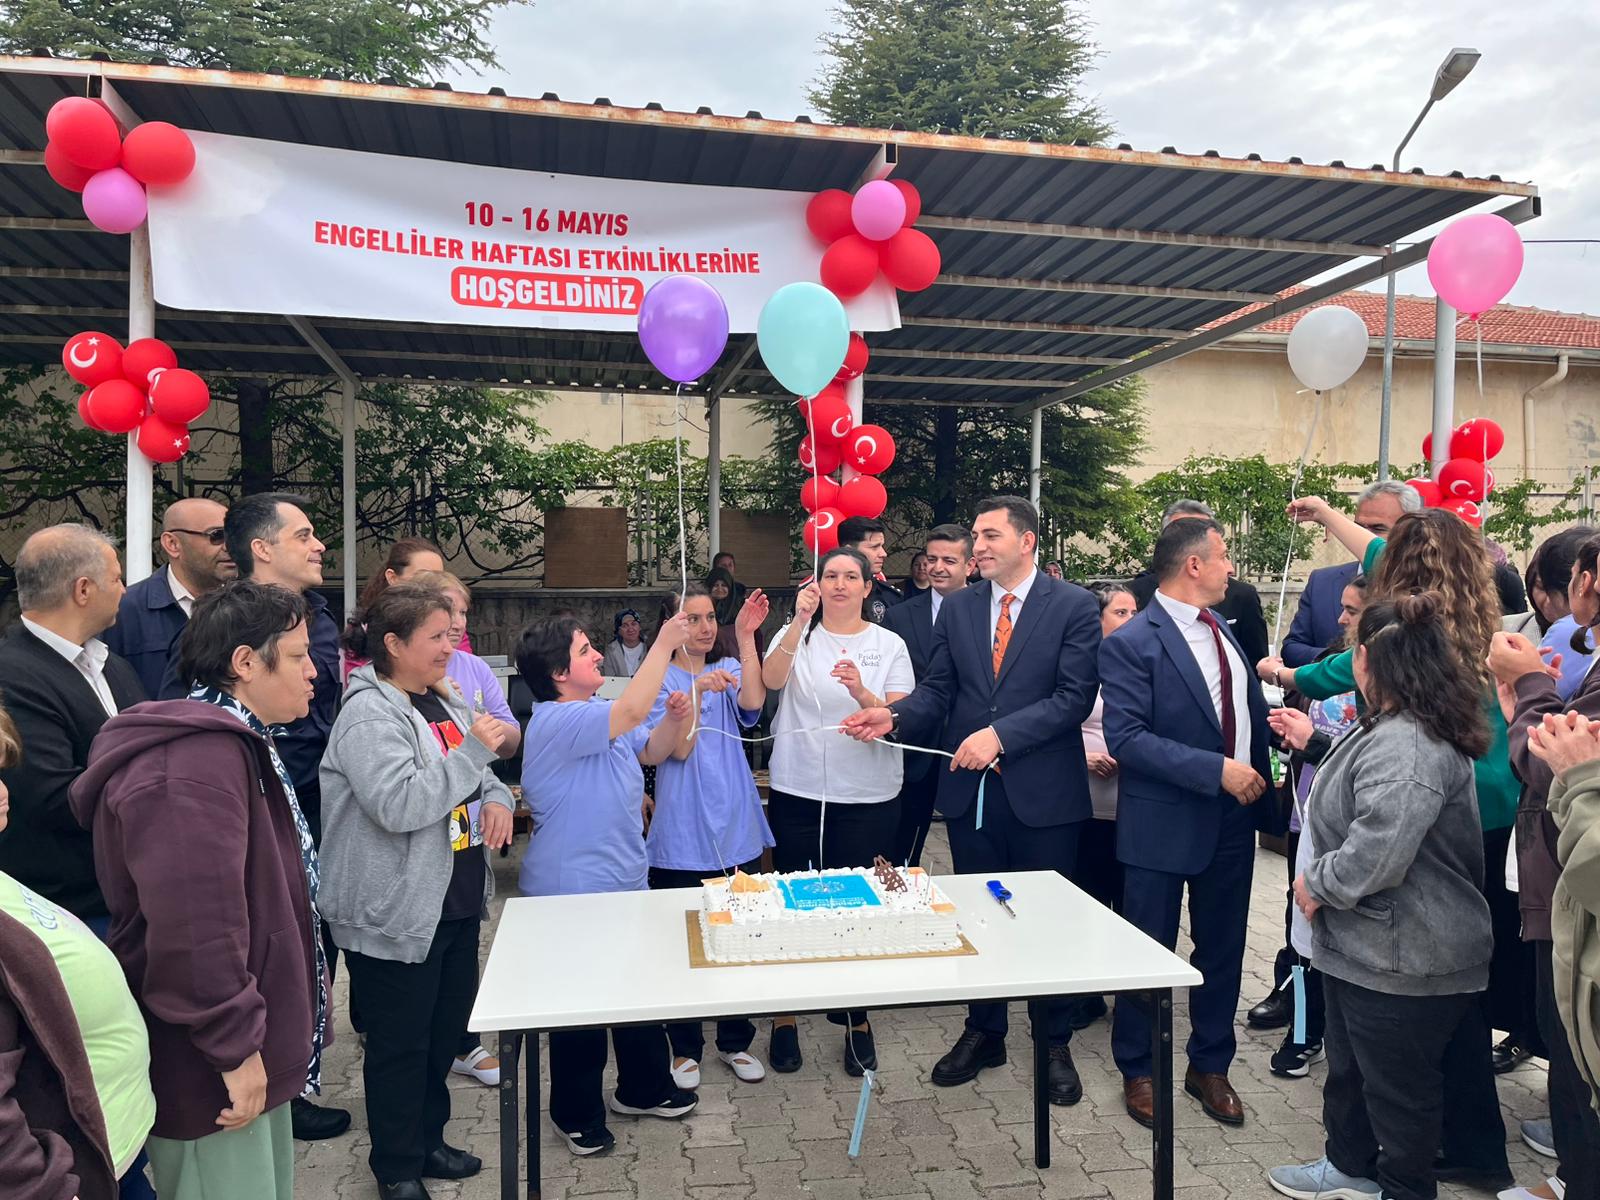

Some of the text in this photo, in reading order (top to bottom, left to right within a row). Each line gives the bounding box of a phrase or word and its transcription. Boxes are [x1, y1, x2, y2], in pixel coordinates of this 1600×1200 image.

[465, 201, 494, 227] 10
[522, 207, 550, 232] 16
[557, 210, 629, 236] MAYIS
[315, 220, 760, 274] ENGELLİLER HAFTASI ETKİNLİKLERİNE
[458, 273, 637, 310] HOŞGELDİNİZ
